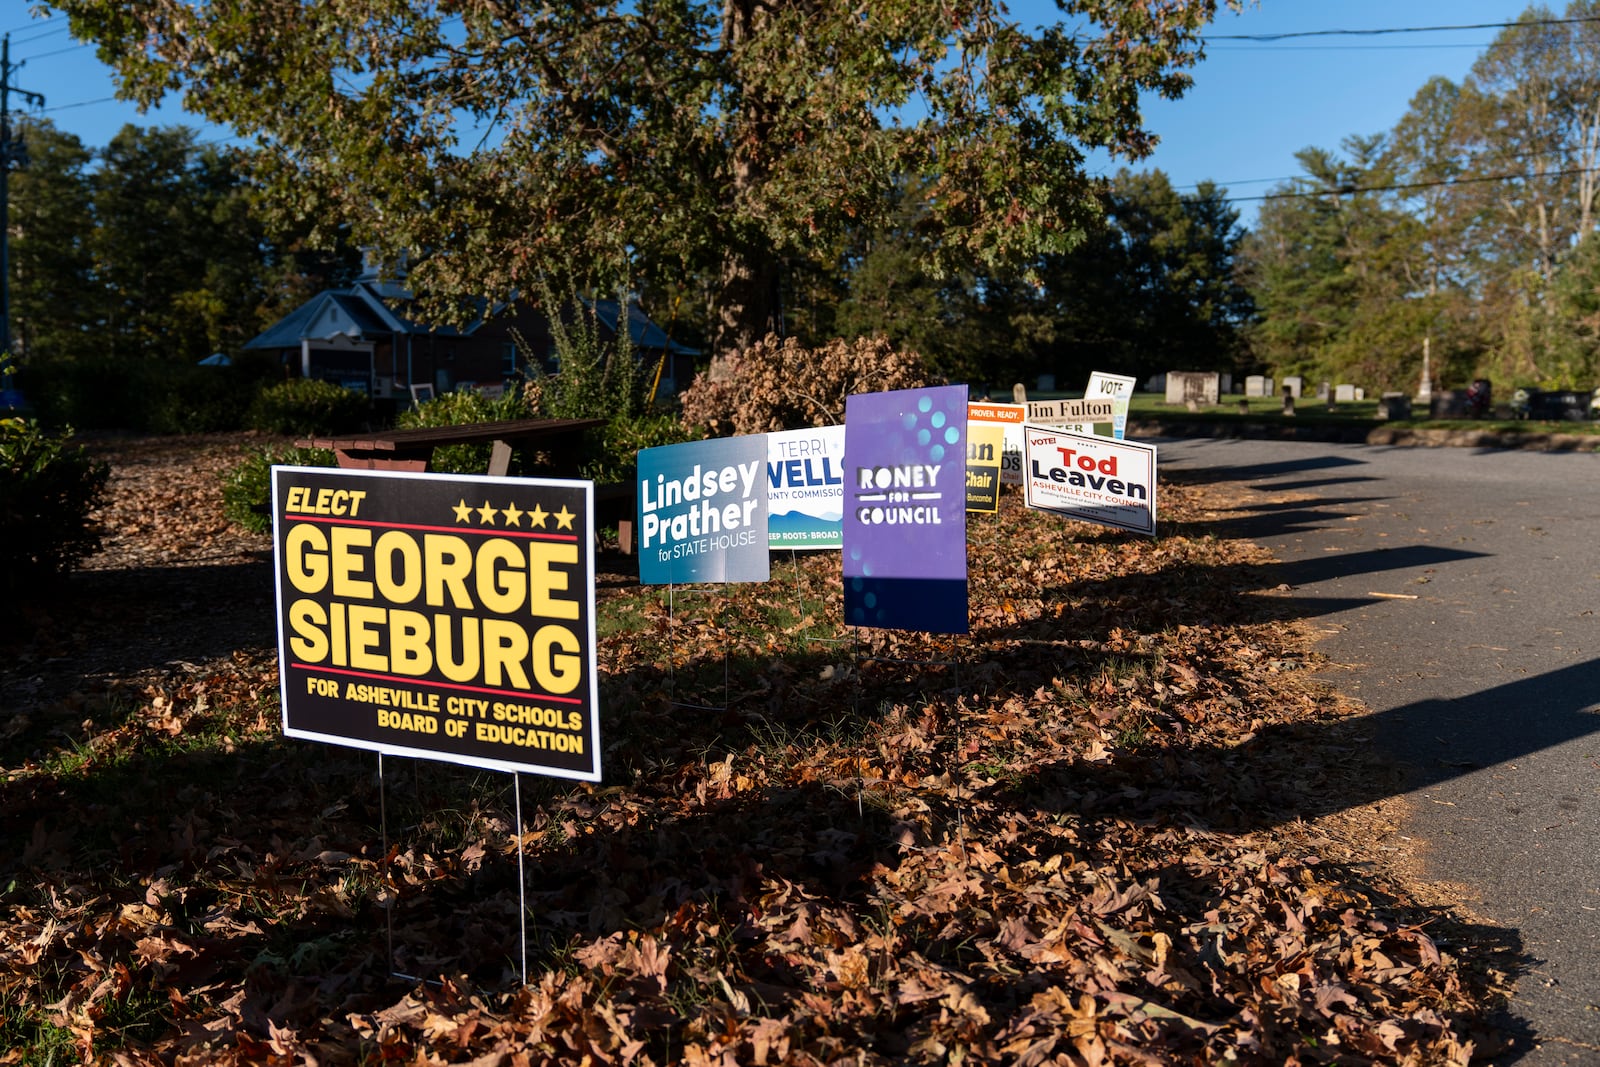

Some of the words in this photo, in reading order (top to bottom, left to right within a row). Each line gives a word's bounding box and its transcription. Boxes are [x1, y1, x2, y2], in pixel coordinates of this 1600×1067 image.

[970, 409, 995, 418] PROVEN.
[997, 410, 1020, 420] READY.
[1028, 403, 1053, 418] Jim
[1060, 401, 1112, 417] Fulton
[778, 438, 827, 458] TERRI
[967, 442, 994, 461] an
[1031, 437, 1056, 448] VOTE!
[1001, 456, 1020, 471] DS
[1057, 447, 1118, 476] Tod
[642, 460, 759, 513] Lindsey
[859, 465, 941, 489] RONEY
[1032, 459, 1147, 500] Leaven
[285, 486, 366, 517] ELECT
[767, 491, 789, 501] UNTY
[792, 488, 843, 499] COMMISSIO
[888, 493, 910, 503] FOR
[1033, 482, 1081, 496] ASHEVILLE
[1083, 489, 1103, 500] CITY
[1105, 495, 1147, 509] COUNCIL
[643, 497, 758, 549] Prather
[859, 507, 942, 526] COUNCIL
[658, 549, 672, 562] for
[673, 540, 707, 559] STATE
[709, 530, 756, 551] HOUSE
[768, 531, 781, 540] EEP
[783, 531, 808, 540] ROOTS
[811, 531, 838, 540] BROAD
[286, 523, 579, 620] GEORGE
[289, 598, 581, 694] SIEBURG
[307, 677, 339, 698] FOR
[345, 683, 440, 712] ASHEVILLE
[447, 697, 490, 718] CITY
[492, 701, 582, 731] SCHOOLS
[377, 709, 438, 734] BOARD
[445, 719, 469, 737] OF
[476, 723, 583, 754] EDUCATION
